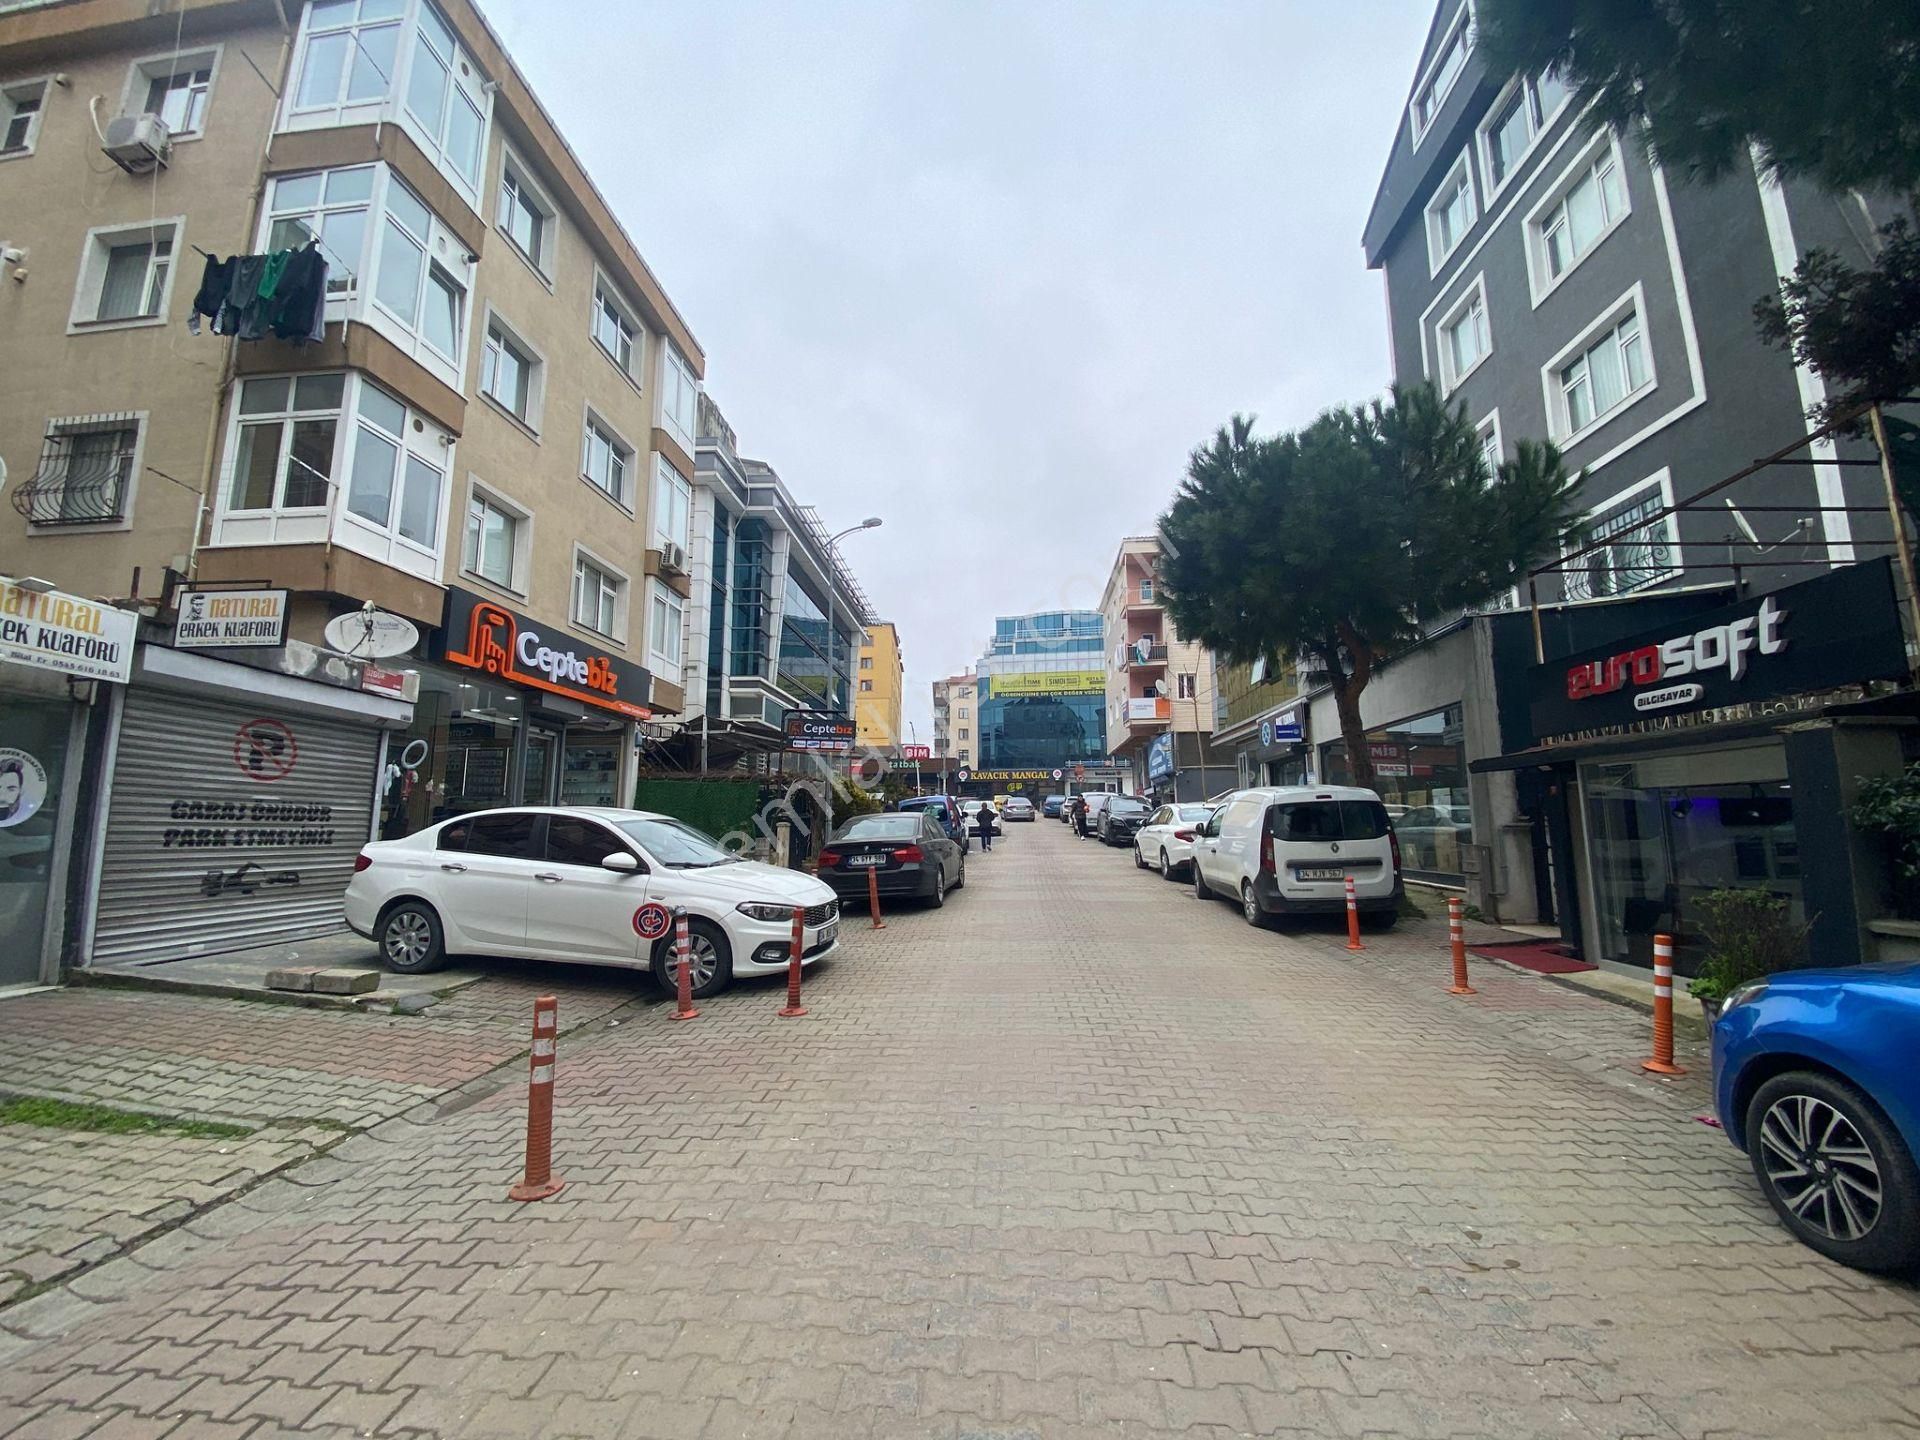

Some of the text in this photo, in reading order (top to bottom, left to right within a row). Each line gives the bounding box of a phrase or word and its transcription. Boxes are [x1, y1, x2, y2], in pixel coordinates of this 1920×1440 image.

[516, 632, 618, 695] Ceptebiz
[803, 723, 853, 735] Ceptebiz
[970, 770, 1049, 780] KAVACIK MANGAL
[170, 800, 247, 821] GARAJ
[163, 828, 229, 847] PARK
